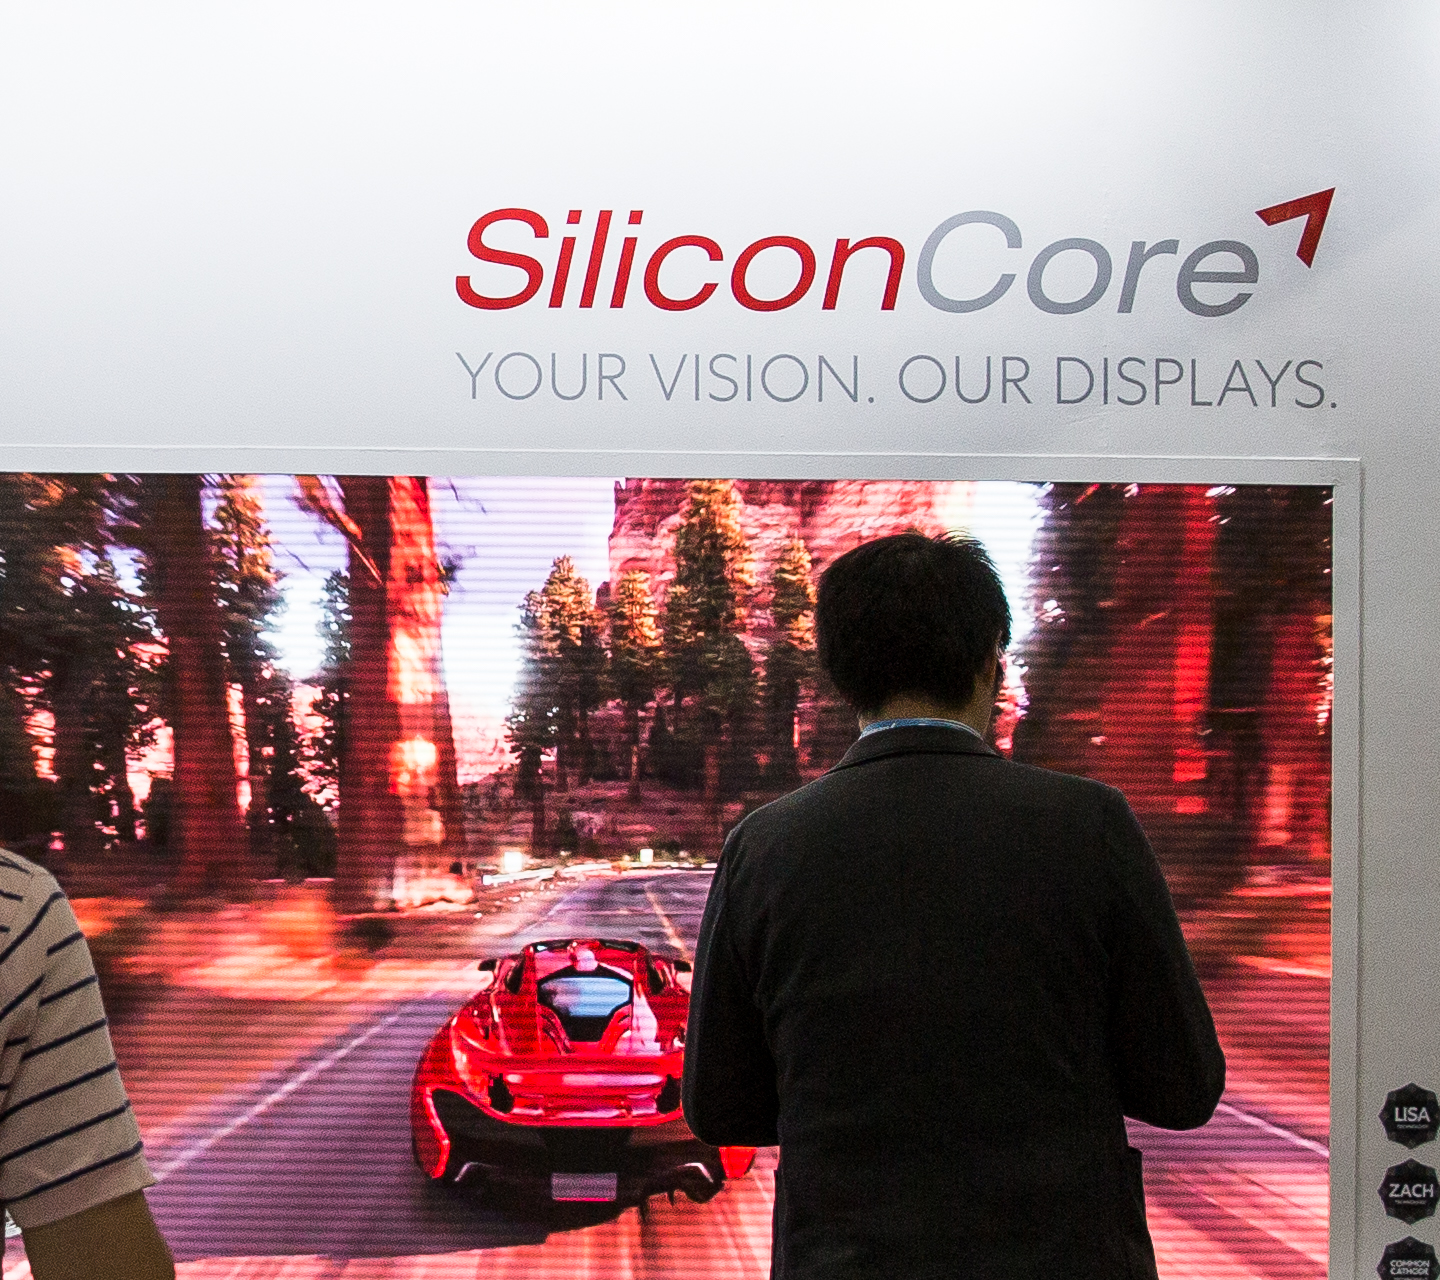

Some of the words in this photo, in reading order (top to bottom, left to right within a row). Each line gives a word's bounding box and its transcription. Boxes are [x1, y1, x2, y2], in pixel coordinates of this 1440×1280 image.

[456, 206, 1259, 318] SiliconCore
[456, 352, 627, 403] YOUR
[649, 353, 876, 404] VISION.
[897, 354, 1032, 405] OUR
[1056, 357, 1338, 409] DISPLAYS.
[1395, 1107, 1431, 1122] LISA
[1389, 1183, 1434, 1198] ZACH
